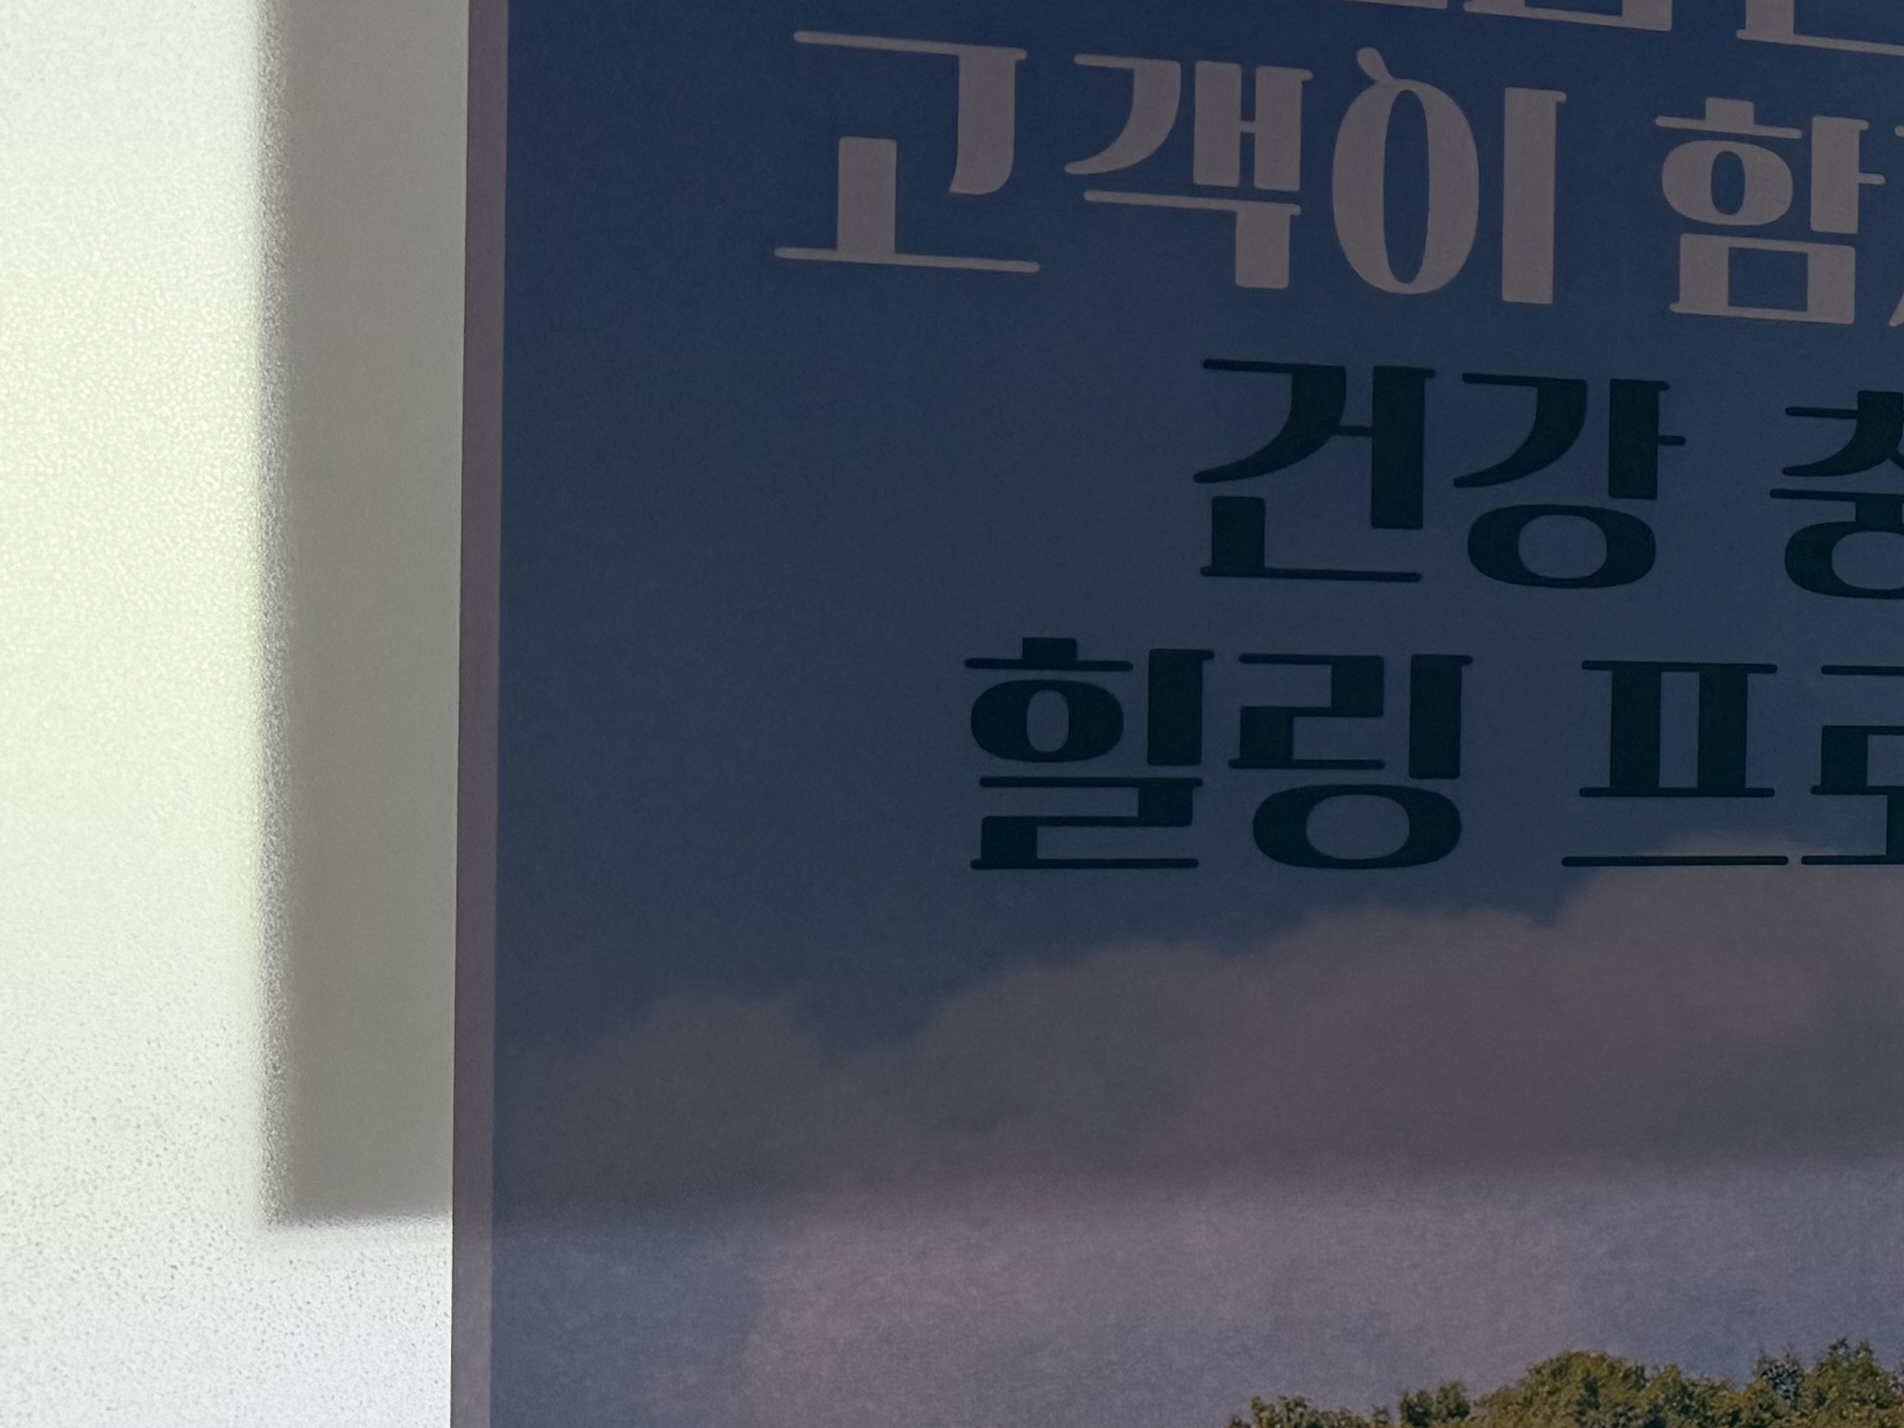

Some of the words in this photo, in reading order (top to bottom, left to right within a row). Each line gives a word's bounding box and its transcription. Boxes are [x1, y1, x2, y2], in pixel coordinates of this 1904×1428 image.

[773, 29, 1568, 305] 고객이
[1192, 357, 1688, 590] 건강
[963, 636, 1475, 871] 힐링
